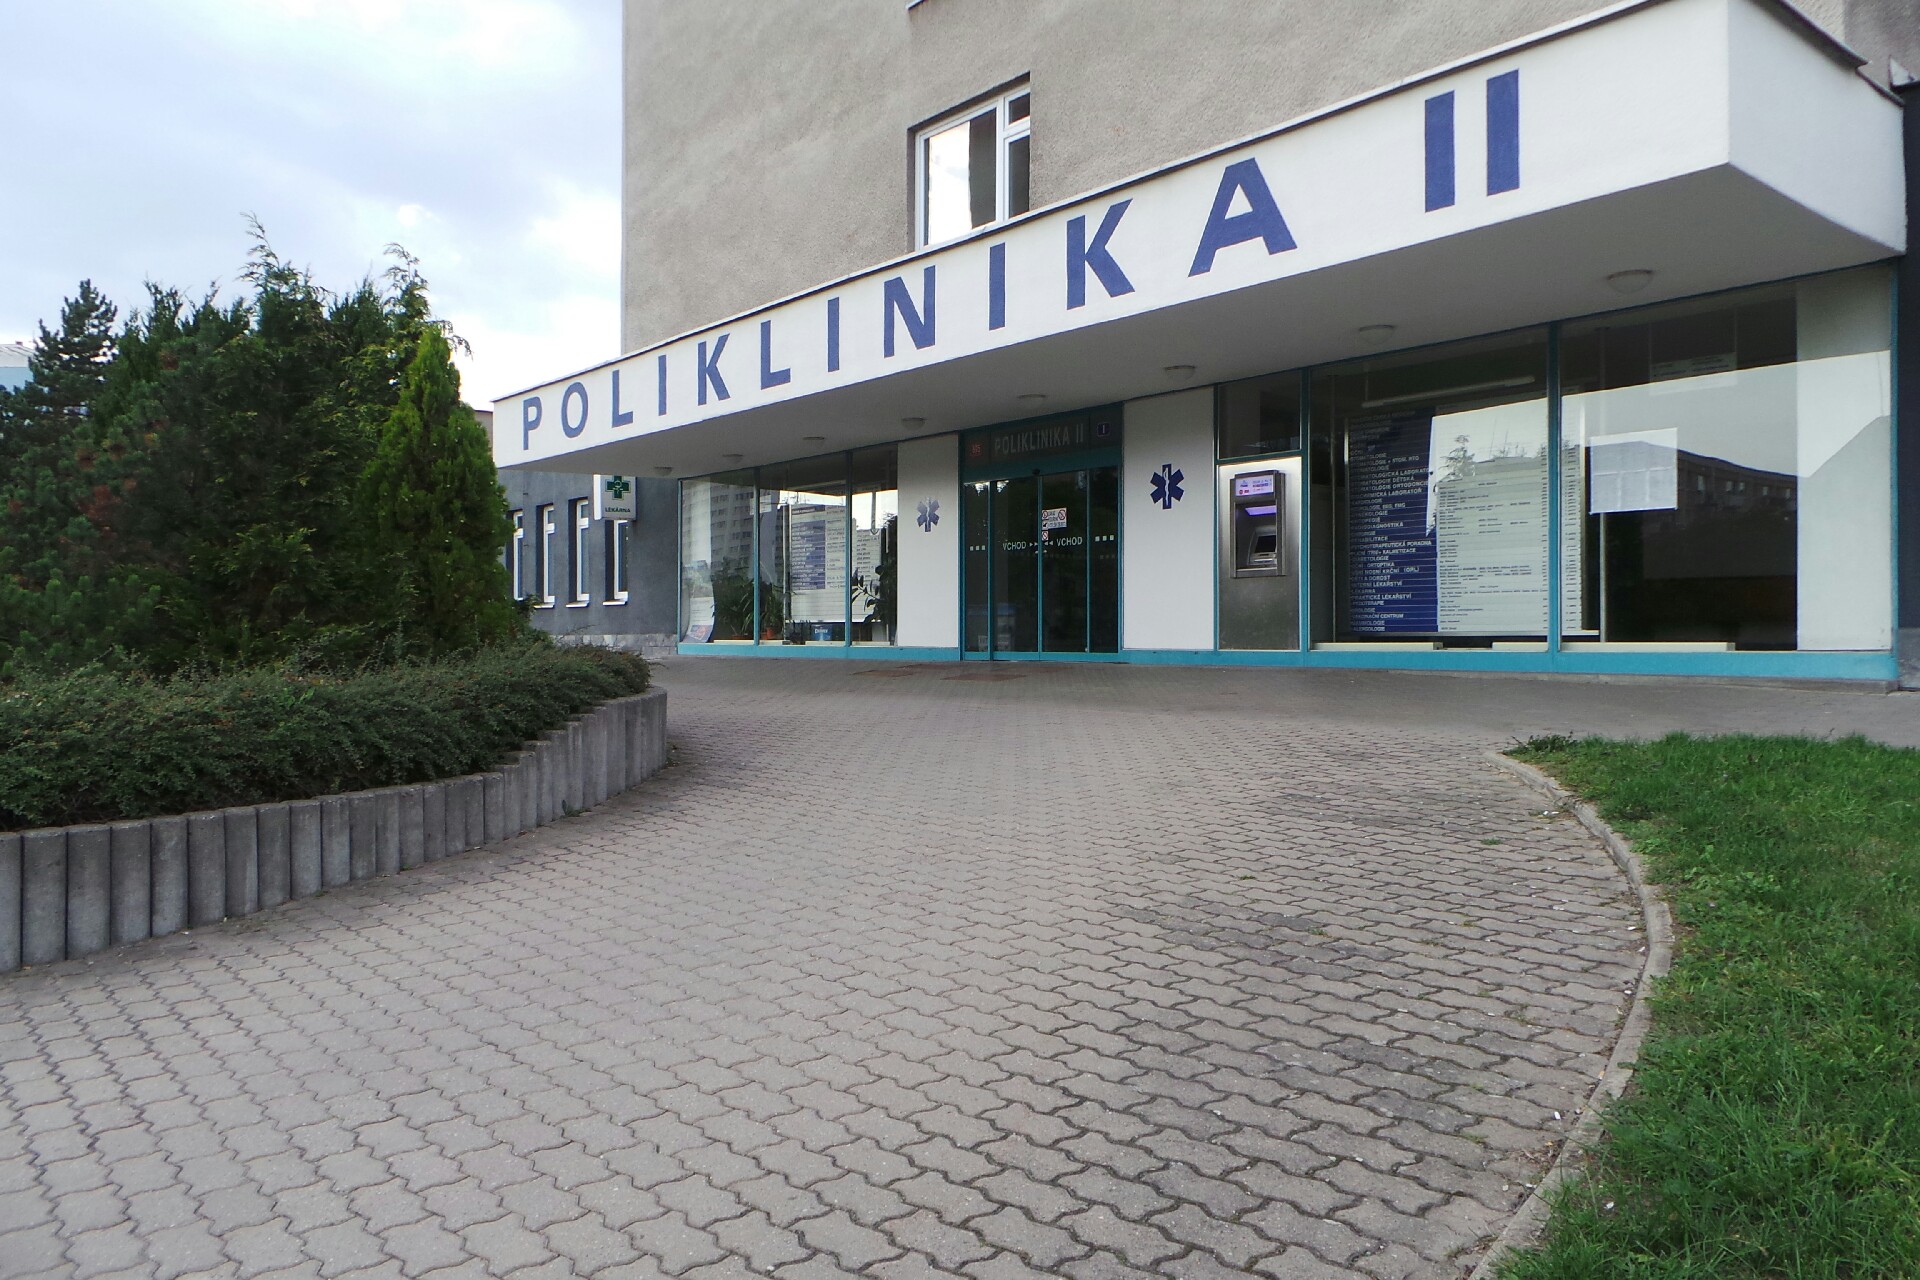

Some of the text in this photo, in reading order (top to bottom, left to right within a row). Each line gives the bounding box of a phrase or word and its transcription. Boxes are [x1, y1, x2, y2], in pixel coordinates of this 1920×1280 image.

[522, 69, 1520, 451] POLIKLINIKA II
[995, 425, 1070, 455] POLIKLINIKA
[1003, 536, 1083, 551] VCHOD VCHOD
